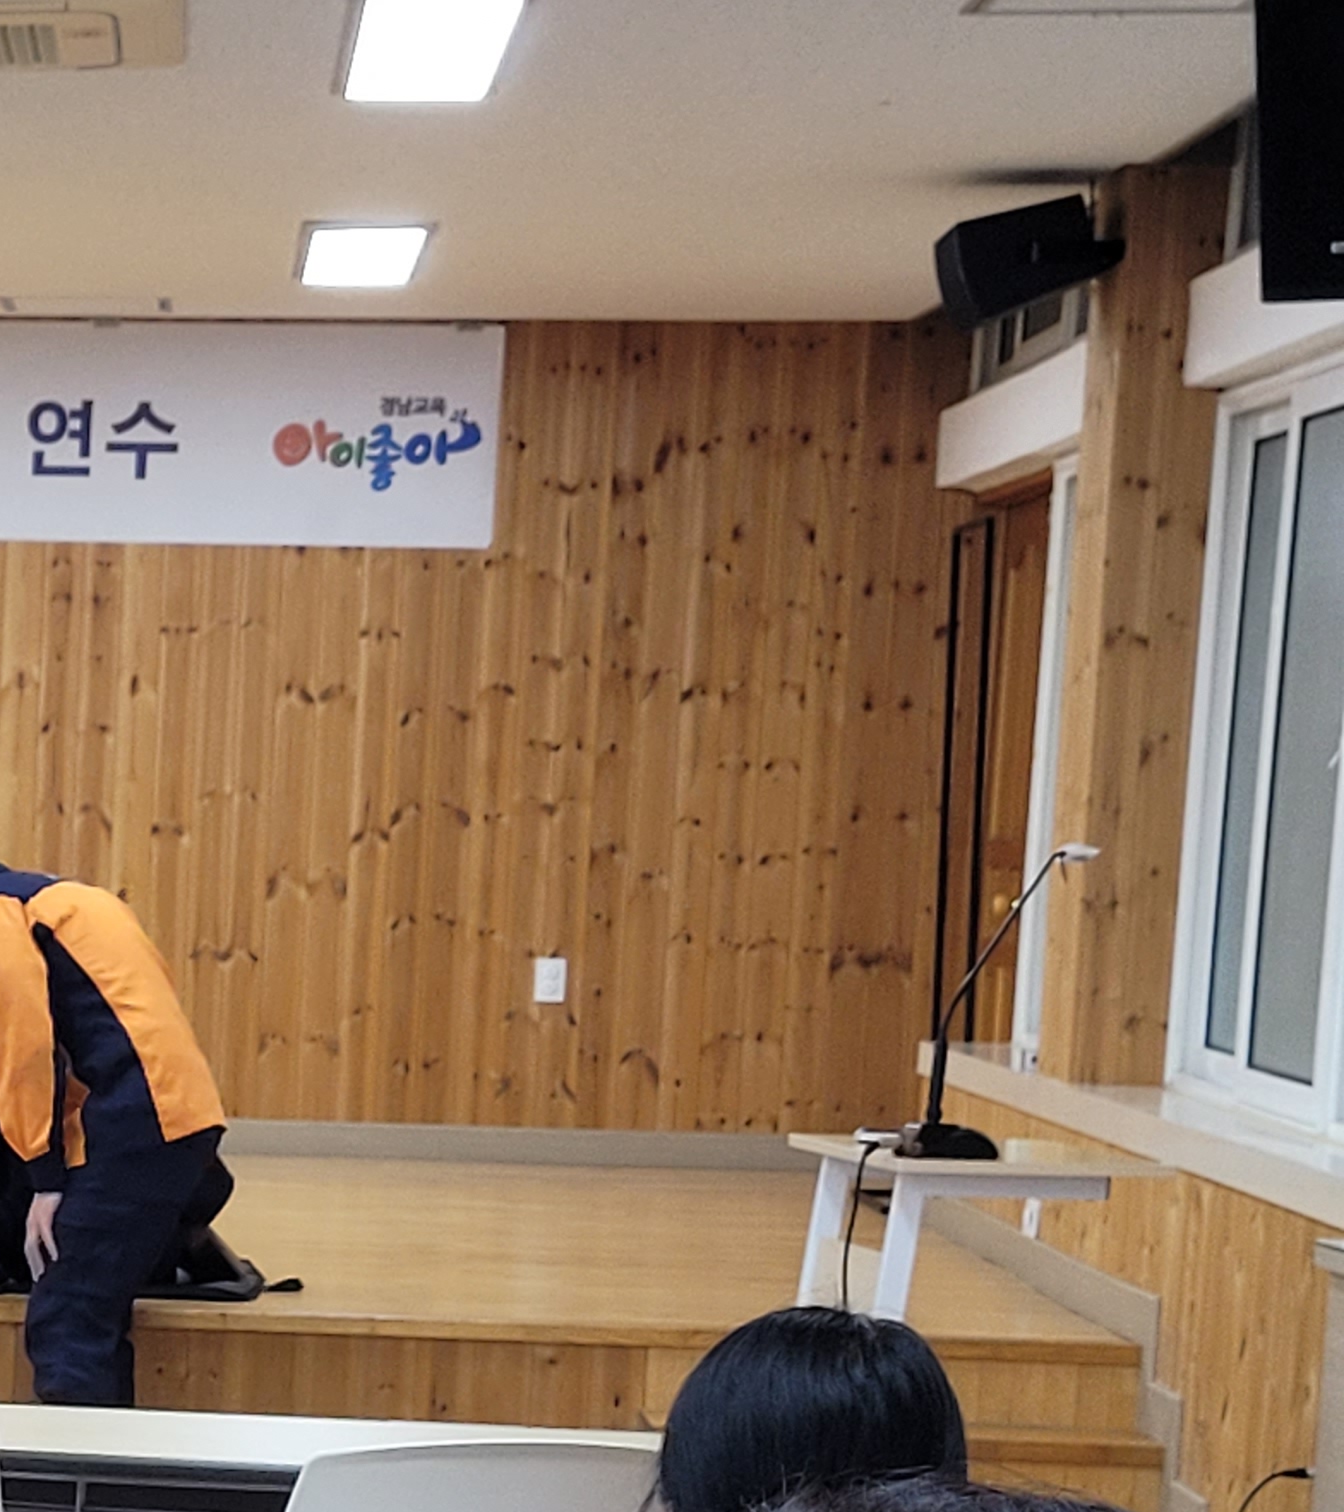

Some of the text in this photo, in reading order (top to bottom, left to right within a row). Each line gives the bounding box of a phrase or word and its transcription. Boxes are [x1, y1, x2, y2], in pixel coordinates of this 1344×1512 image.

[27, 398, 180, 480] 연수
[380, 396, 446, 417] 경남교육
[272, 415, 483, 492] 아이좋아
